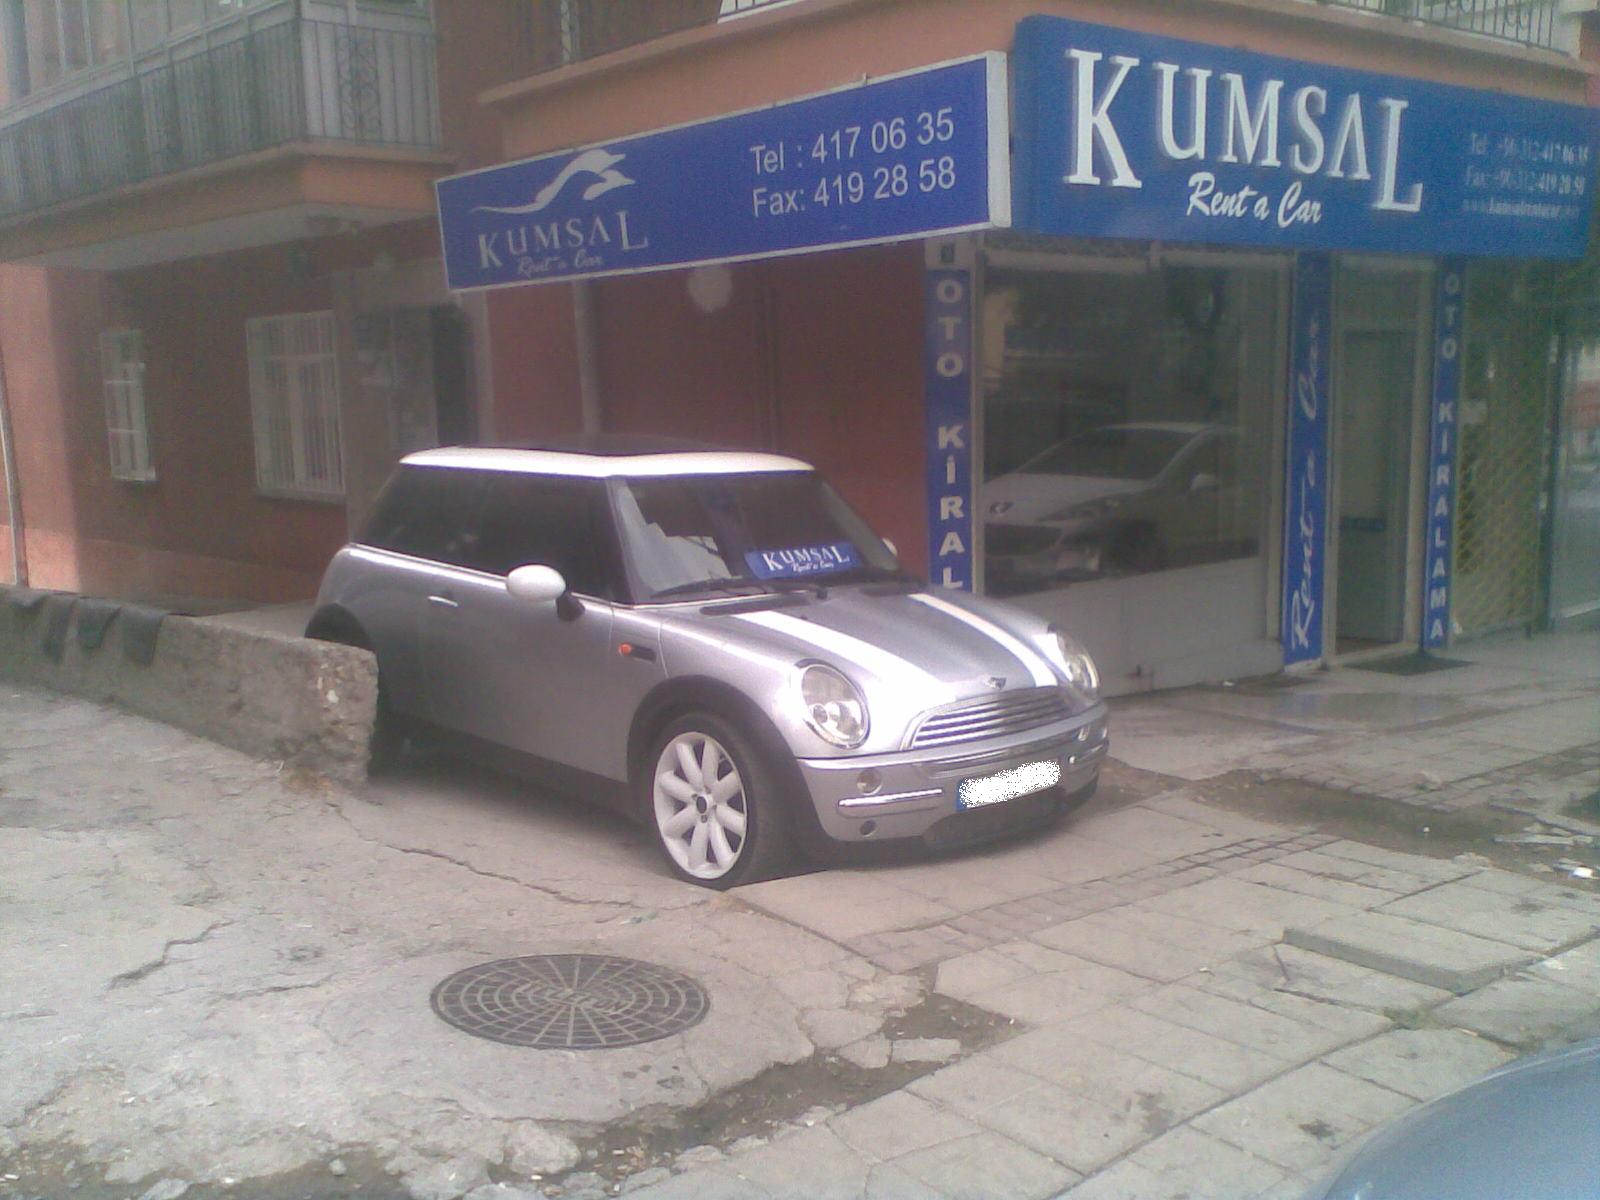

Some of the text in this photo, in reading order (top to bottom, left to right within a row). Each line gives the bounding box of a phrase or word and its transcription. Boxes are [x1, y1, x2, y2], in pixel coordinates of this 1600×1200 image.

[750, 142, 784, 175] Tel
[812, 127, 861, 164] 417
[871, 117, 907, 154] 06
[917, 107, 955, 146] 35
[1062, 48, 1424, 212] KUMSAL
[752, 156, 956, 217] Fax: 419 28 58
[1186, 171, 1323, 228] Rent a Car
[478, 211, 649, 269] KUMSAL
[936, 278, 964, 379] OTO
[1442, 272, 1459, 360] OTO
[762, 546, 850, 572] KUMSAL
